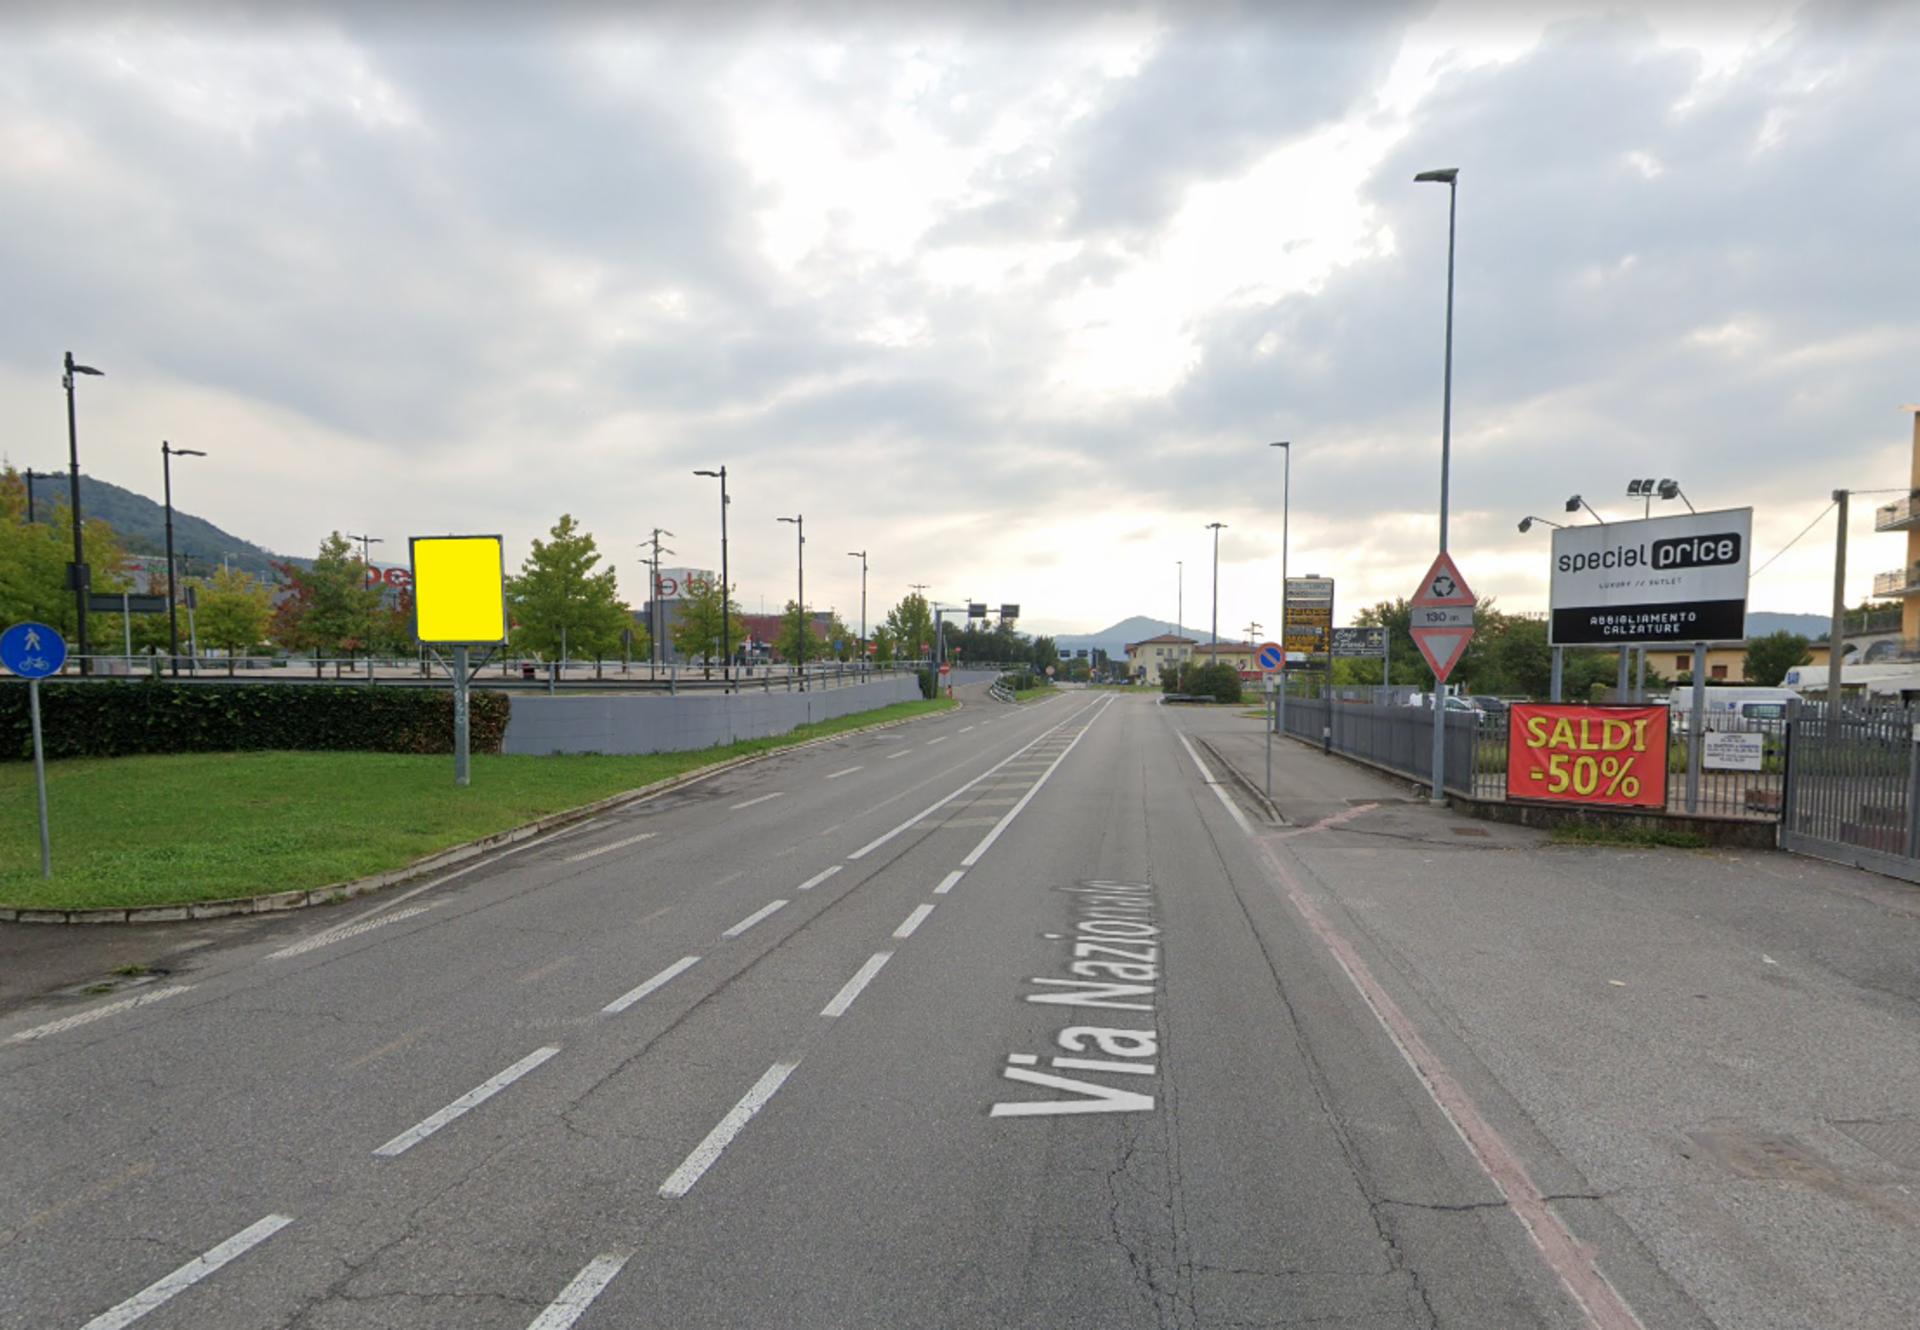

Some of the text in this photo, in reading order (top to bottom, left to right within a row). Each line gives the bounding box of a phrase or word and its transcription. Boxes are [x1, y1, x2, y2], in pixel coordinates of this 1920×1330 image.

[1558, 538, 1734, 574] special price
[1425, 611, 1447, 622] 130
[1590, 611, 1697, 626] ABBIGLIAMENTO
[1603, 623, 1681, 636] CALZATURE
[1526, 716, 1648, 752] SALDI
[1530, 753, 1641, 798] -50%
